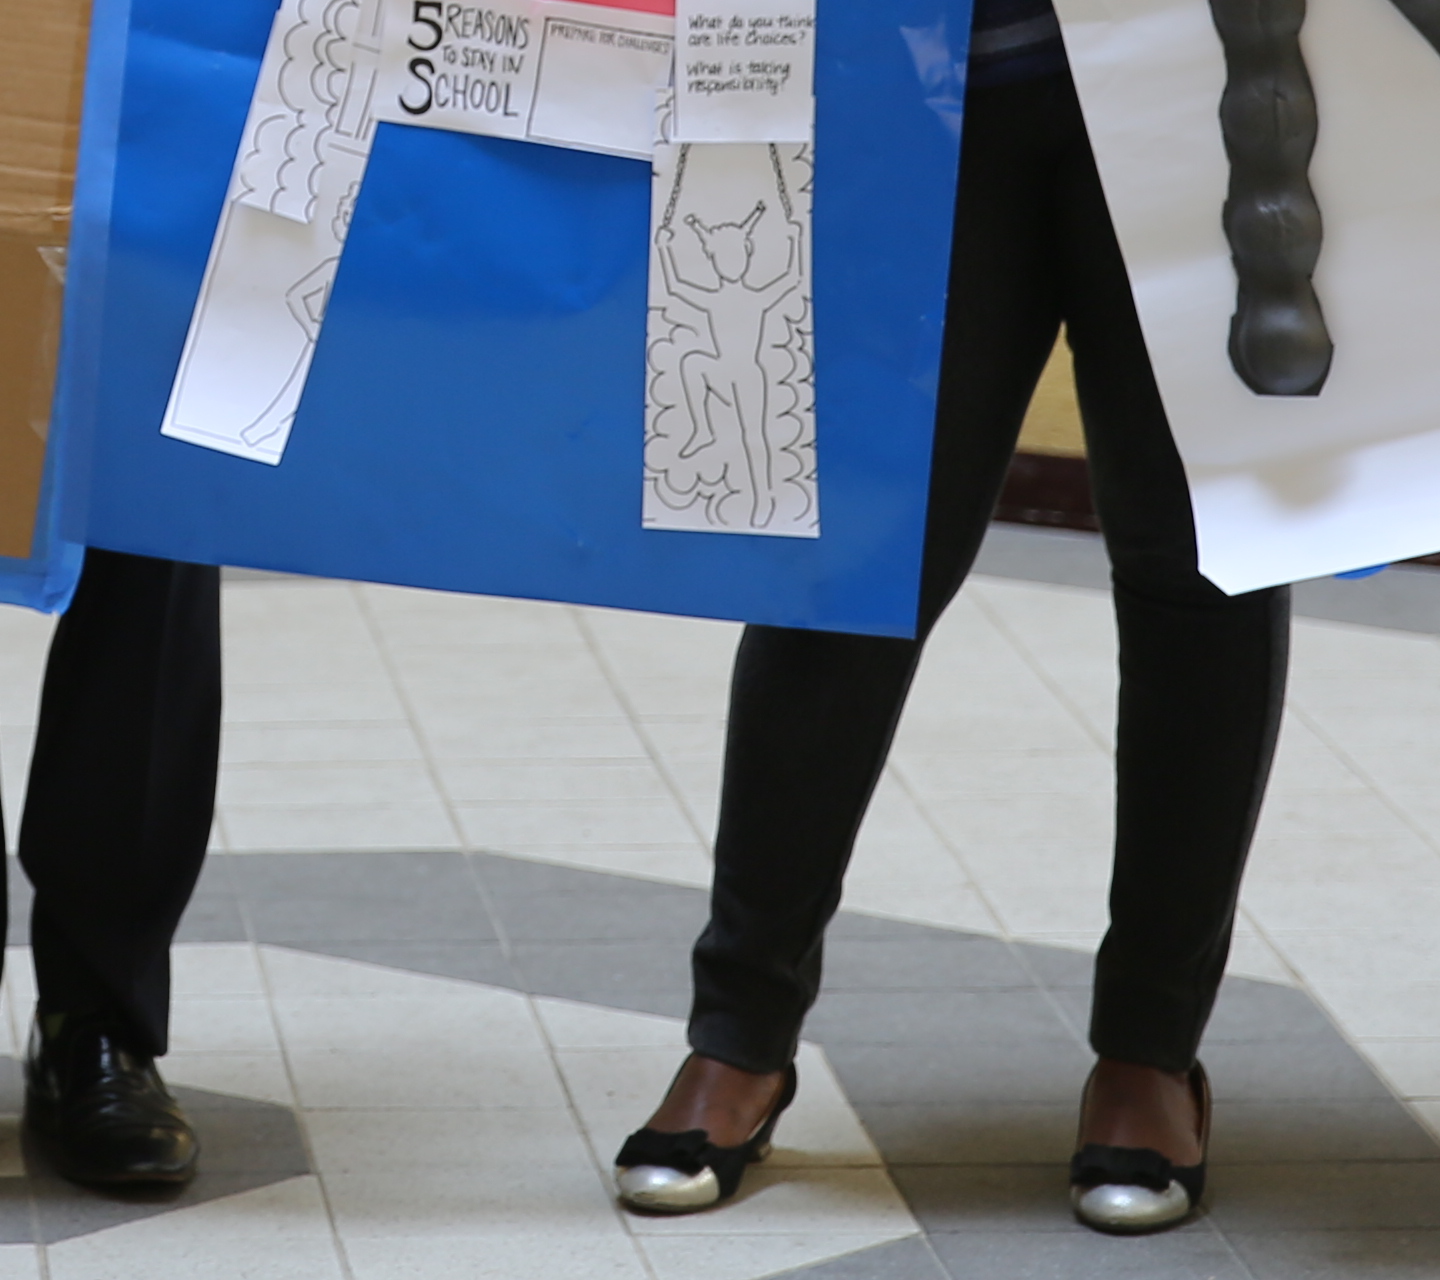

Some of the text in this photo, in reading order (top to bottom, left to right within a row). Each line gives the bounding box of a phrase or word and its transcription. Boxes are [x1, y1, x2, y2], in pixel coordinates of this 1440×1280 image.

[407, 0, 531, 52] 5 REASONS
[688, 14, 816, 32] What do you think
[688, 34, 712, 47] are
[716, 29, 740, 47] life
[460, 47, 497, 74] STAY
[502, 54, 527, 75] IN
[686, 61, 791, 81] What is taking
[398, 57, 519, 117] SCHOOL
